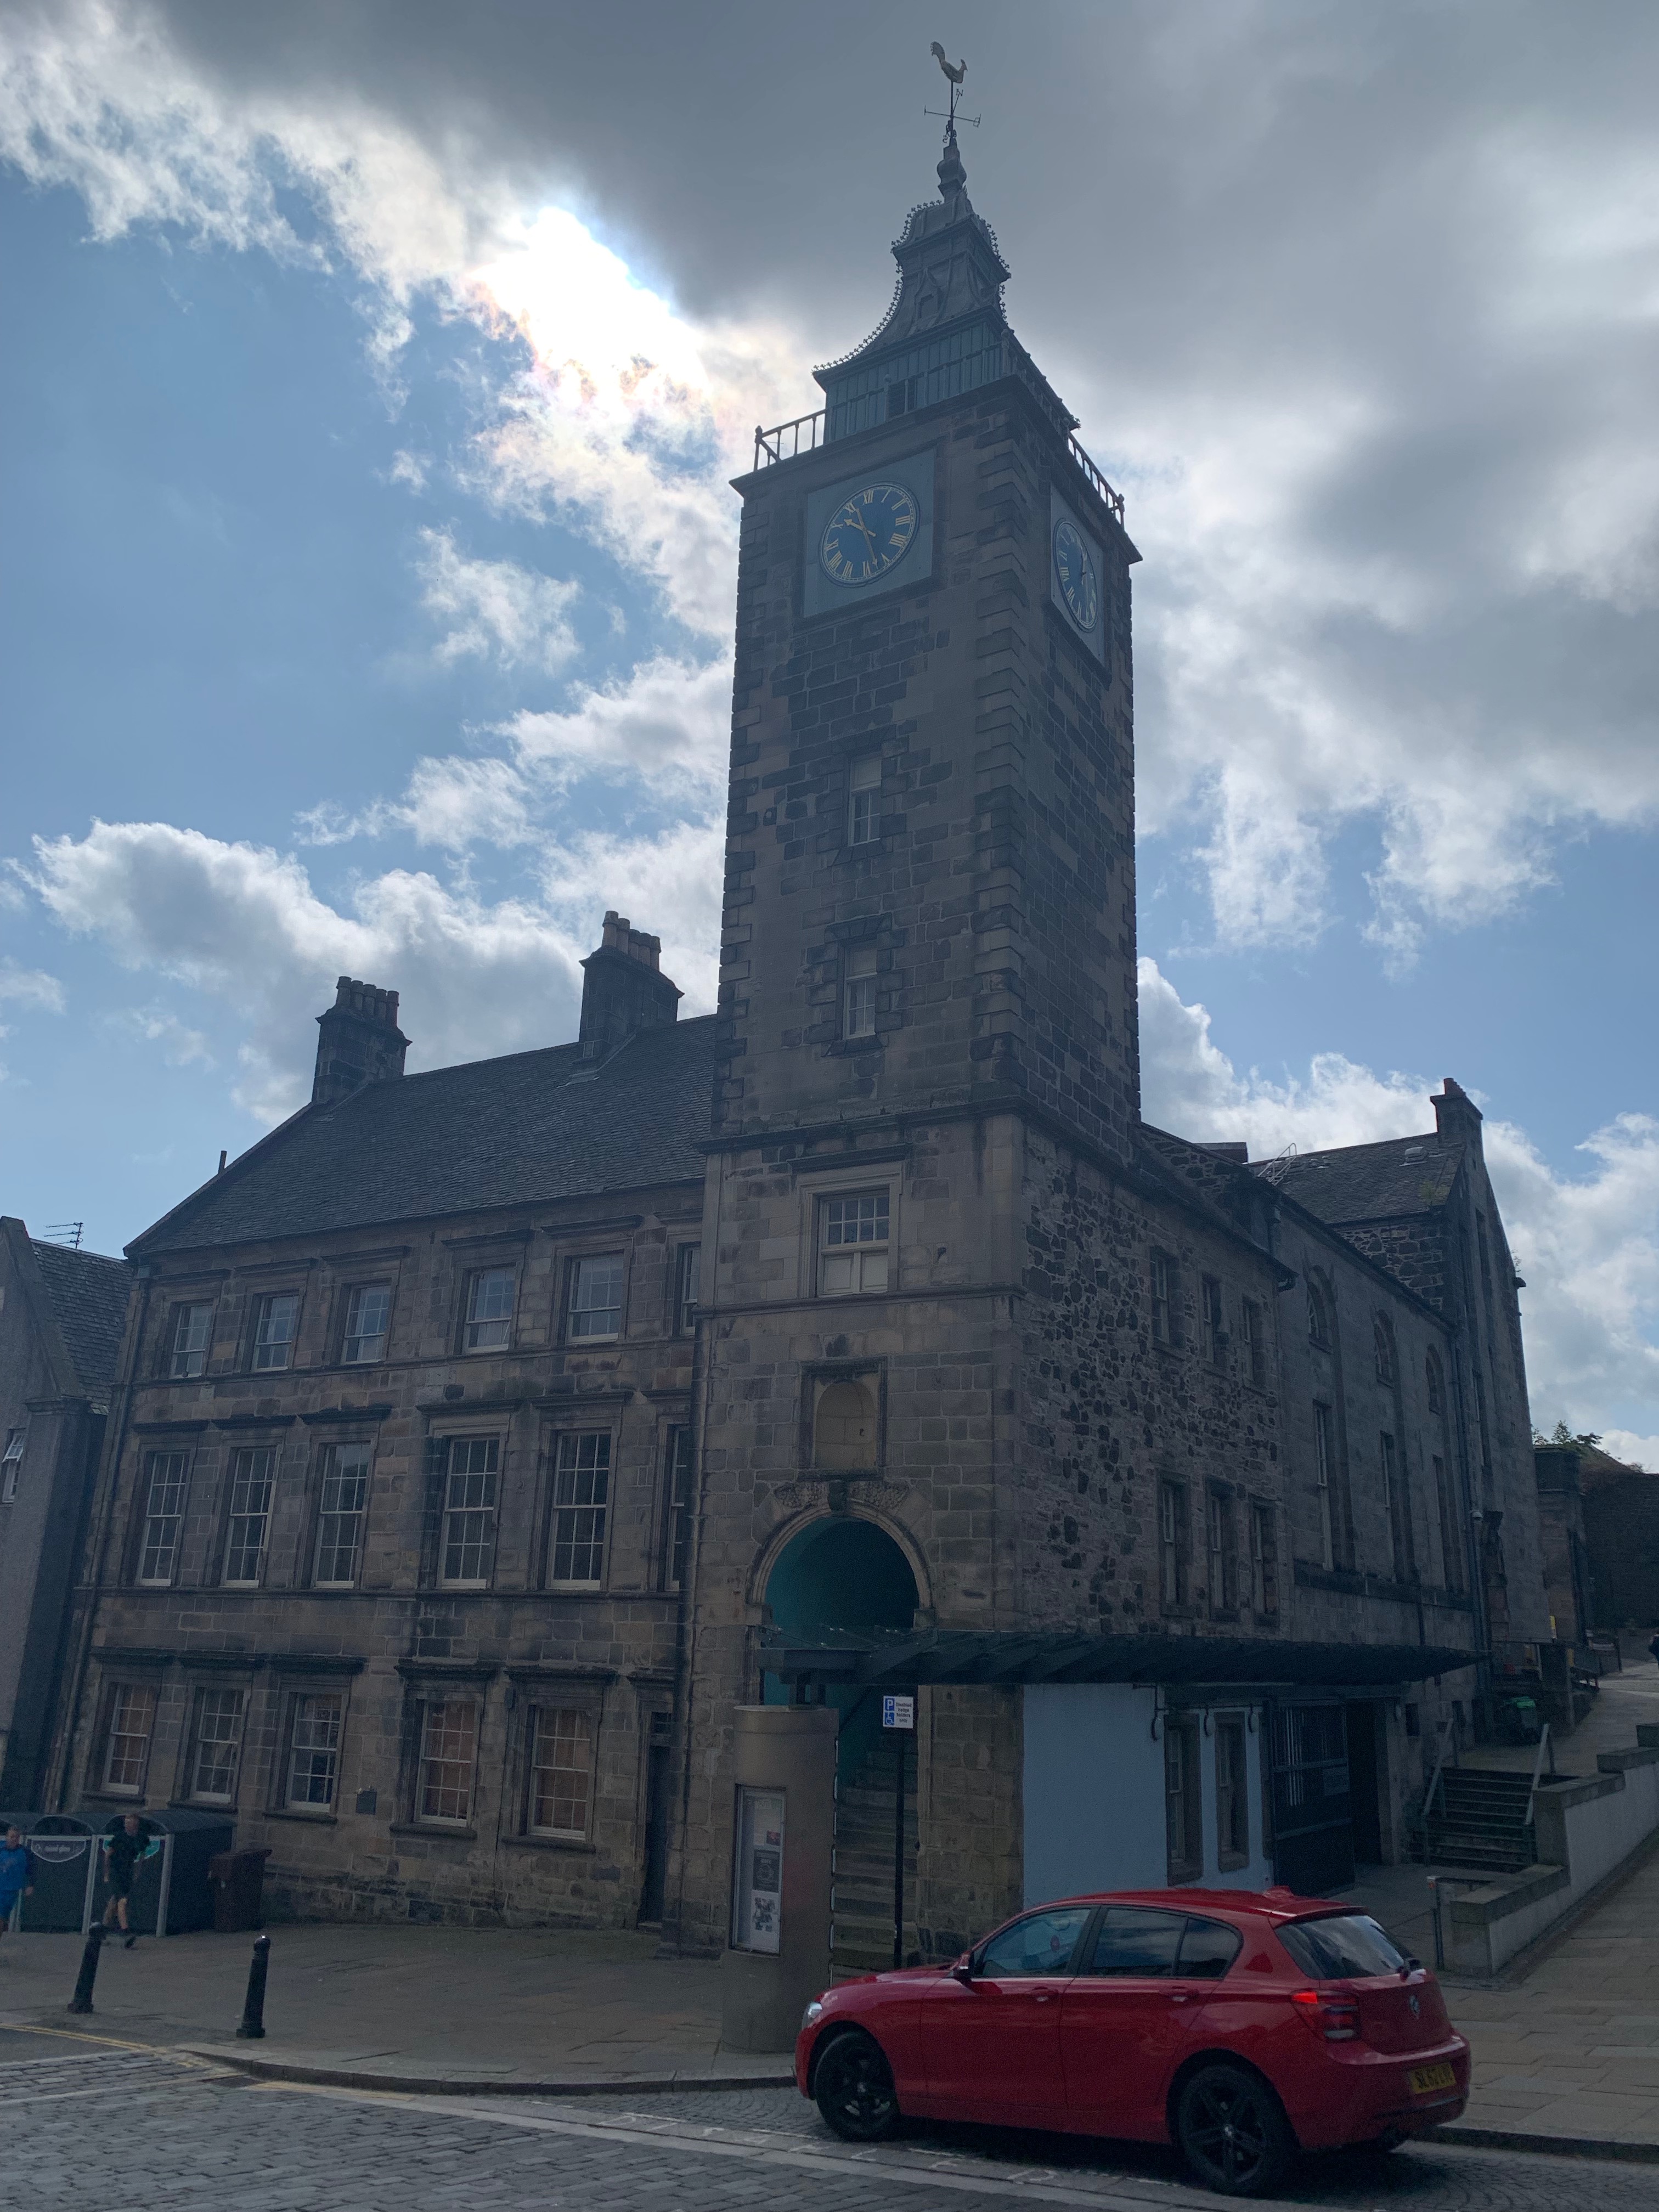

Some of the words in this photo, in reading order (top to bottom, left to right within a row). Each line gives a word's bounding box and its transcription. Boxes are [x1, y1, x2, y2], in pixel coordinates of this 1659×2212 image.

[862, 490, 874, 505] XII
[891, 498, 906, 511] II
[895, 515, 911, 526] III
[889, 532, 906, 547] IIII
[887, 1699, 893, 1710] P
